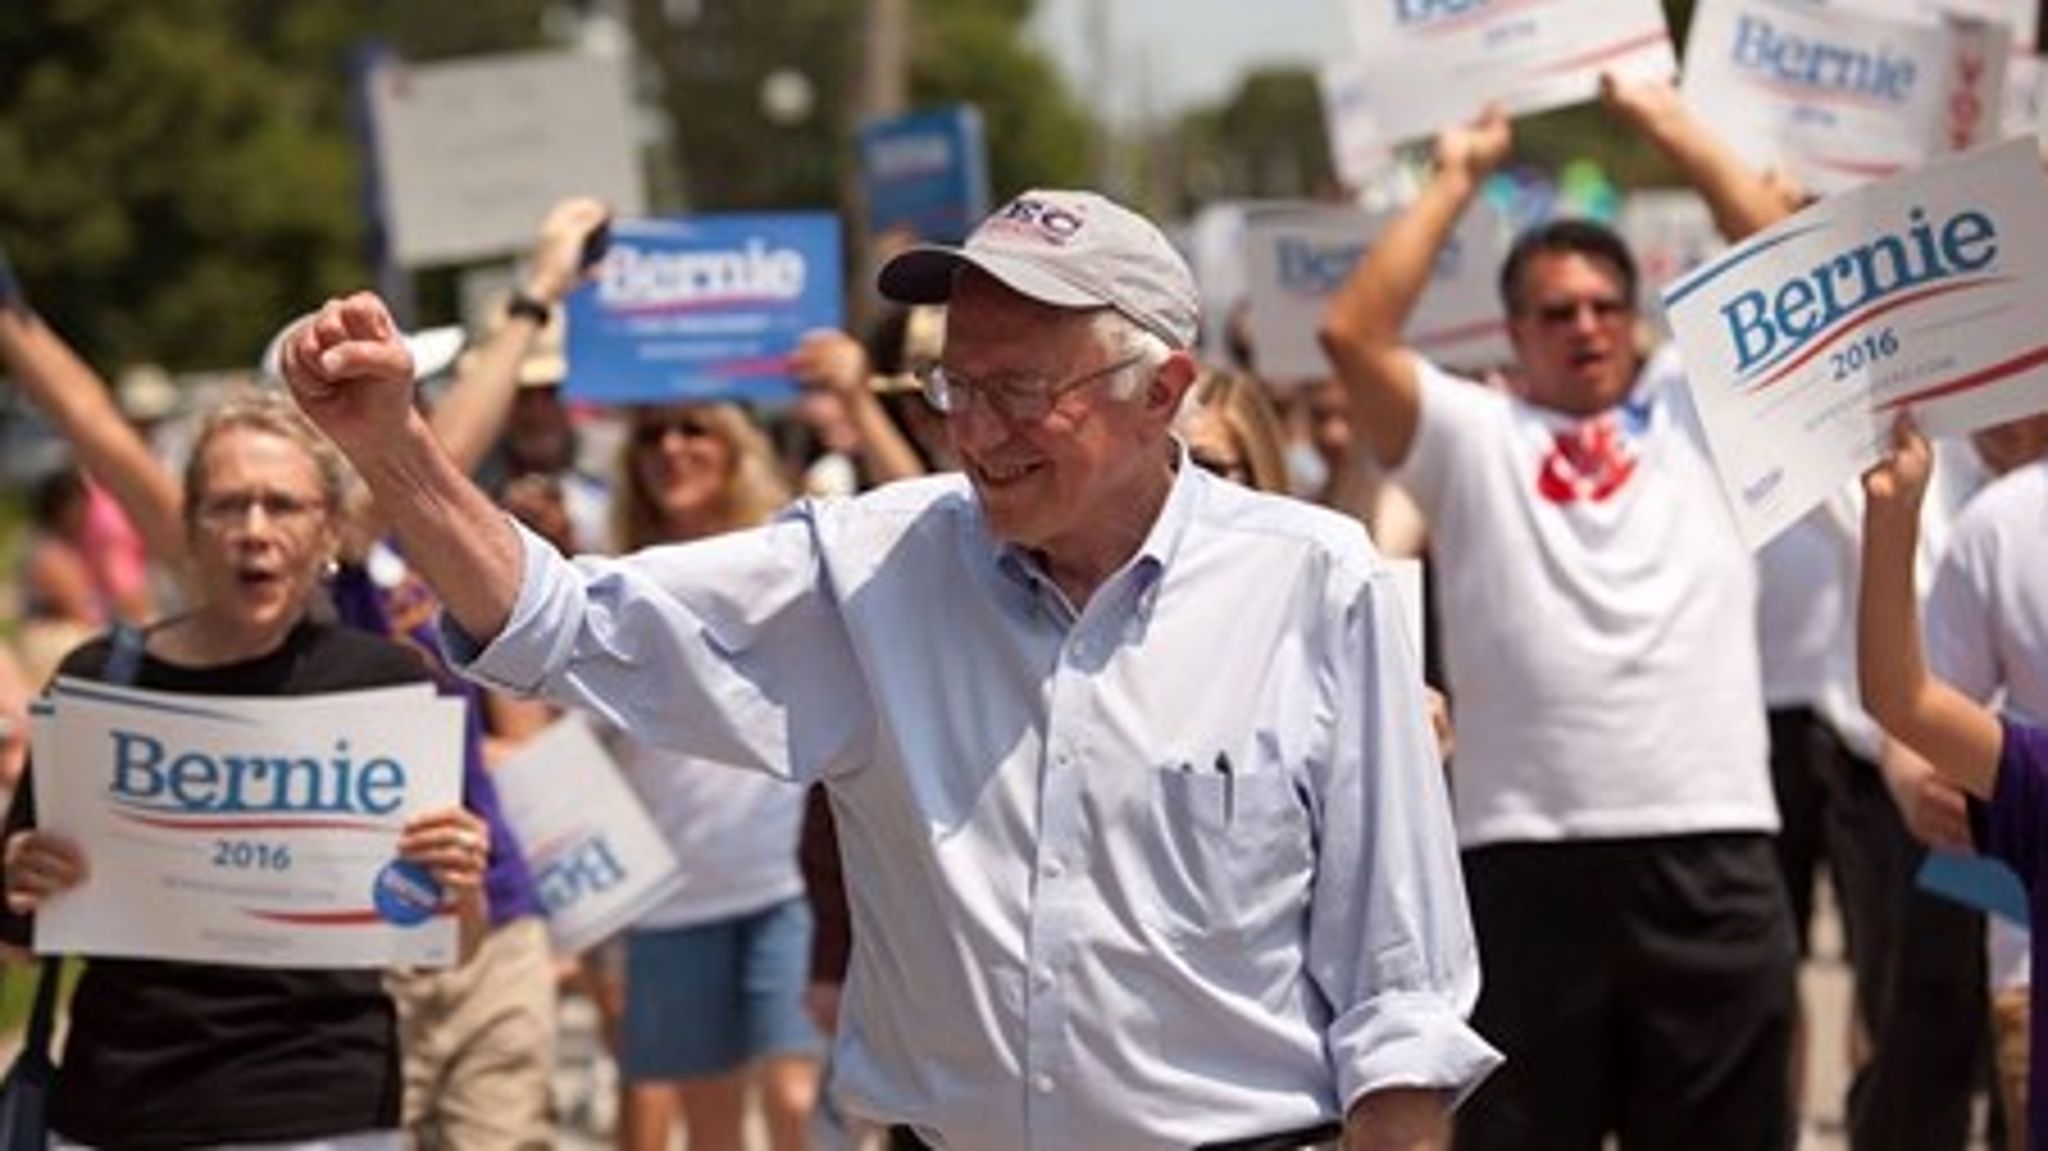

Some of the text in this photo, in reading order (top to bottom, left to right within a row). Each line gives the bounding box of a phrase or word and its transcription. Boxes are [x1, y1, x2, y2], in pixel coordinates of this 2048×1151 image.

[1734, 14, 1915, 103] Bernie
[599, 238, 807, 306] Bernie
[1720, 207, 1998, 373] Bernie
[1829, 327, 1899, 382] 2016
[109, 730, 406, 814] Bernie
[213, 840, 291, 871] 2016
